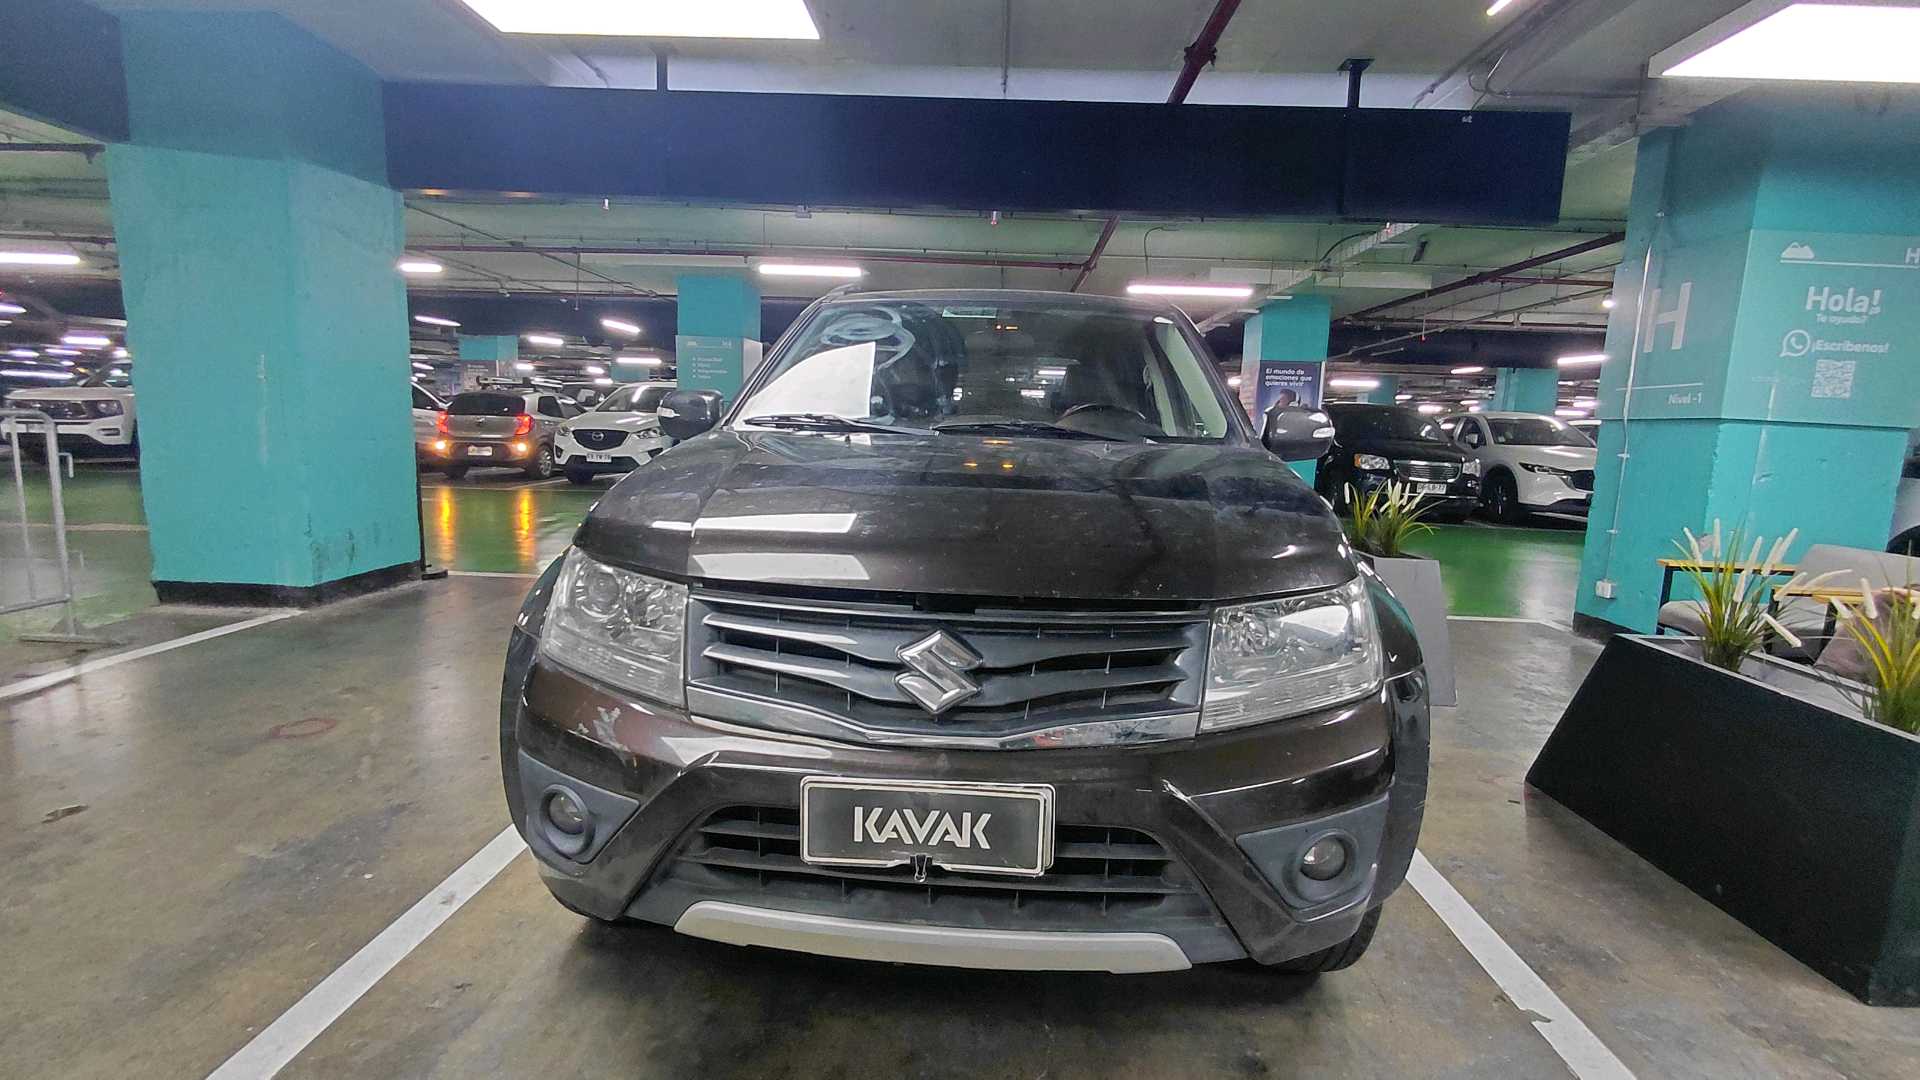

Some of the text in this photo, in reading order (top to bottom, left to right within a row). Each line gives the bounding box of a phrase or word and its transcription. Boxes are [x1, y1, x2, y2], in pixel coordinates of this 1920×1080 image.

[1643, 281, 1692, 353] H
[1806, 286, 1882, 315] Hola!
[853, 806, 992, 850] KAVAK
